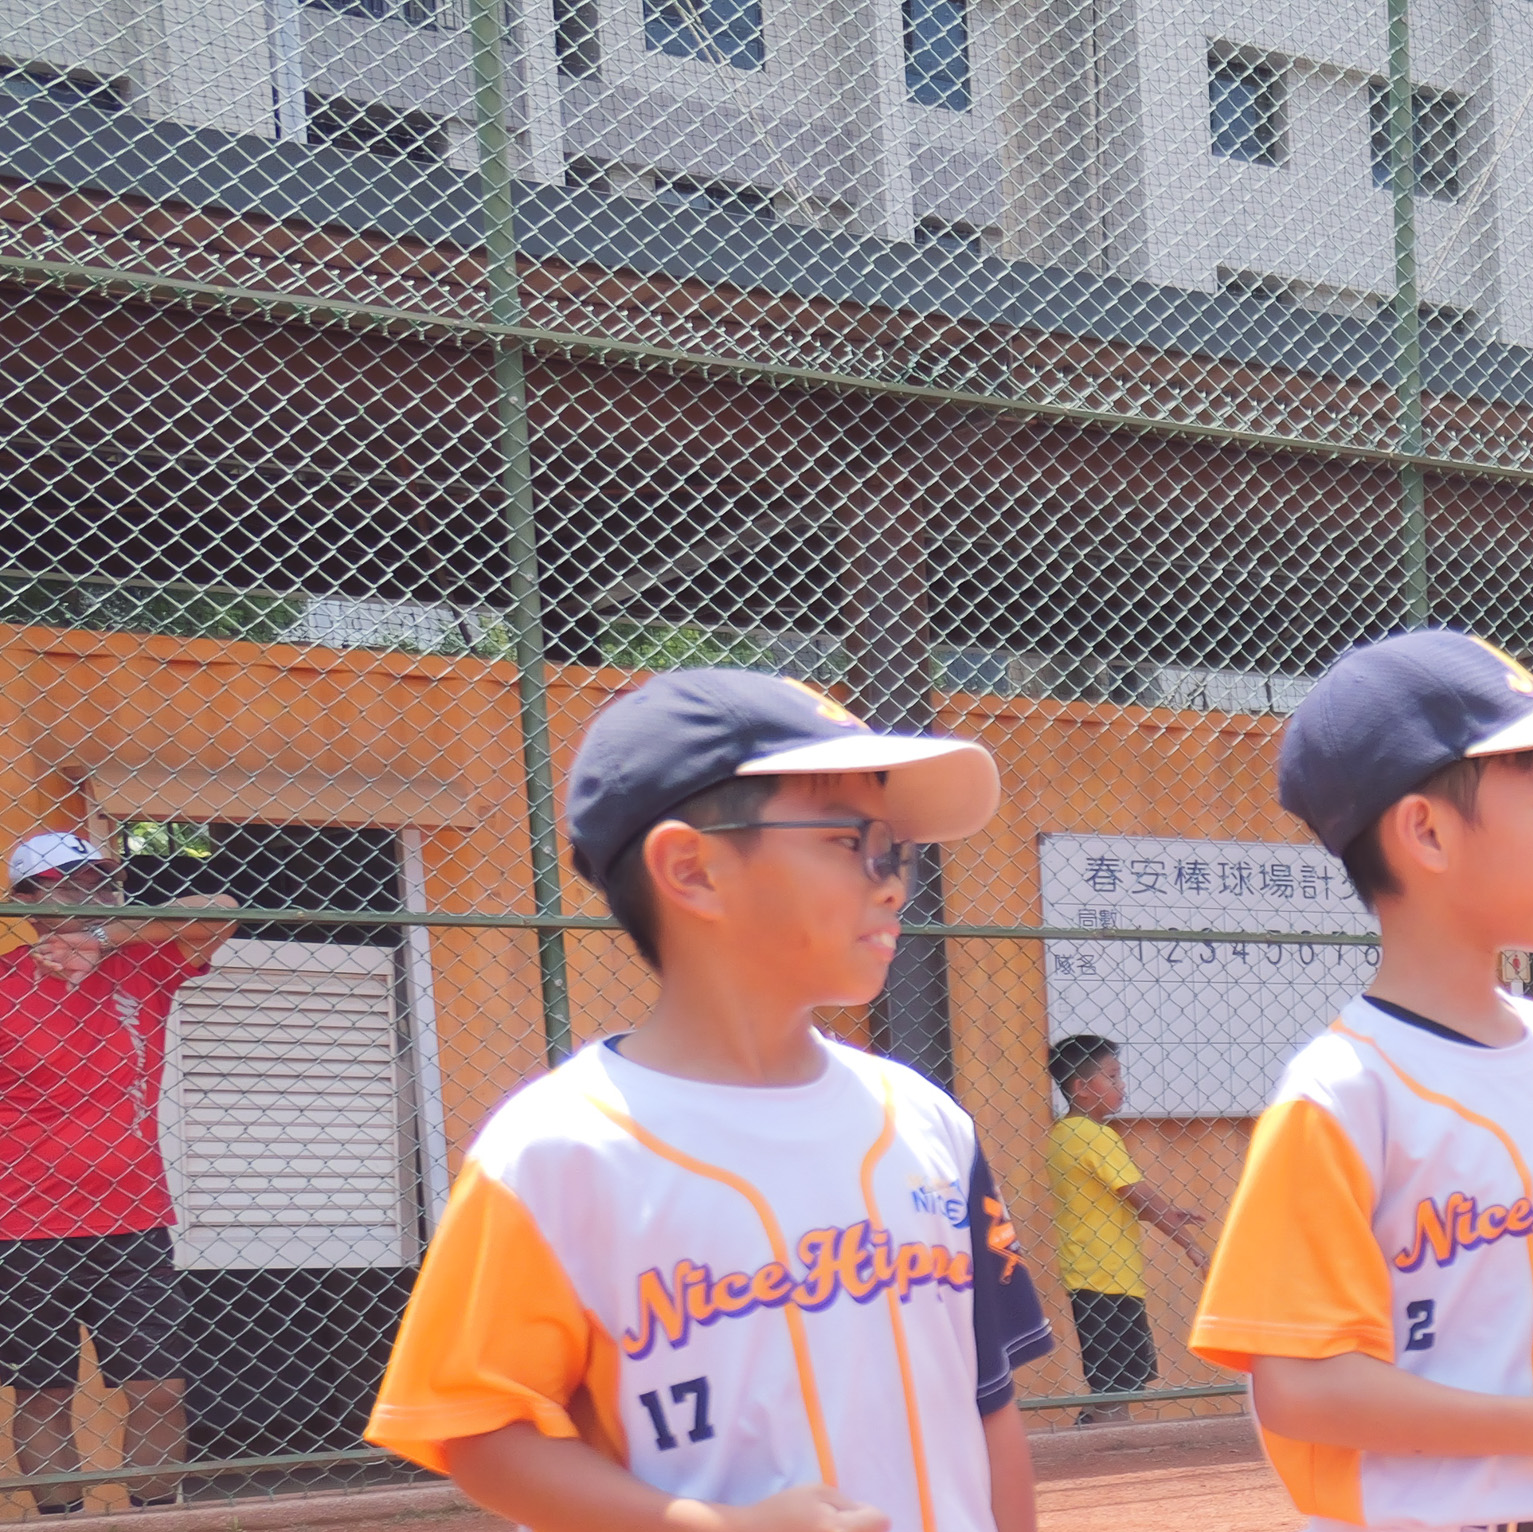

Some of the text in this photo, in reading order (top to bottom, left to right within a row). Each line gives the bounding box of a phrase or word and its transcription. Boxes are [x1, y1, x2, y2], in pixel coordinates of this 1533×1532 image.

[1054, 953, 1098, 977] 隊名
[1404, 1299, 1435, 1352] 2
[639, 1376, 715, 1453] 17
